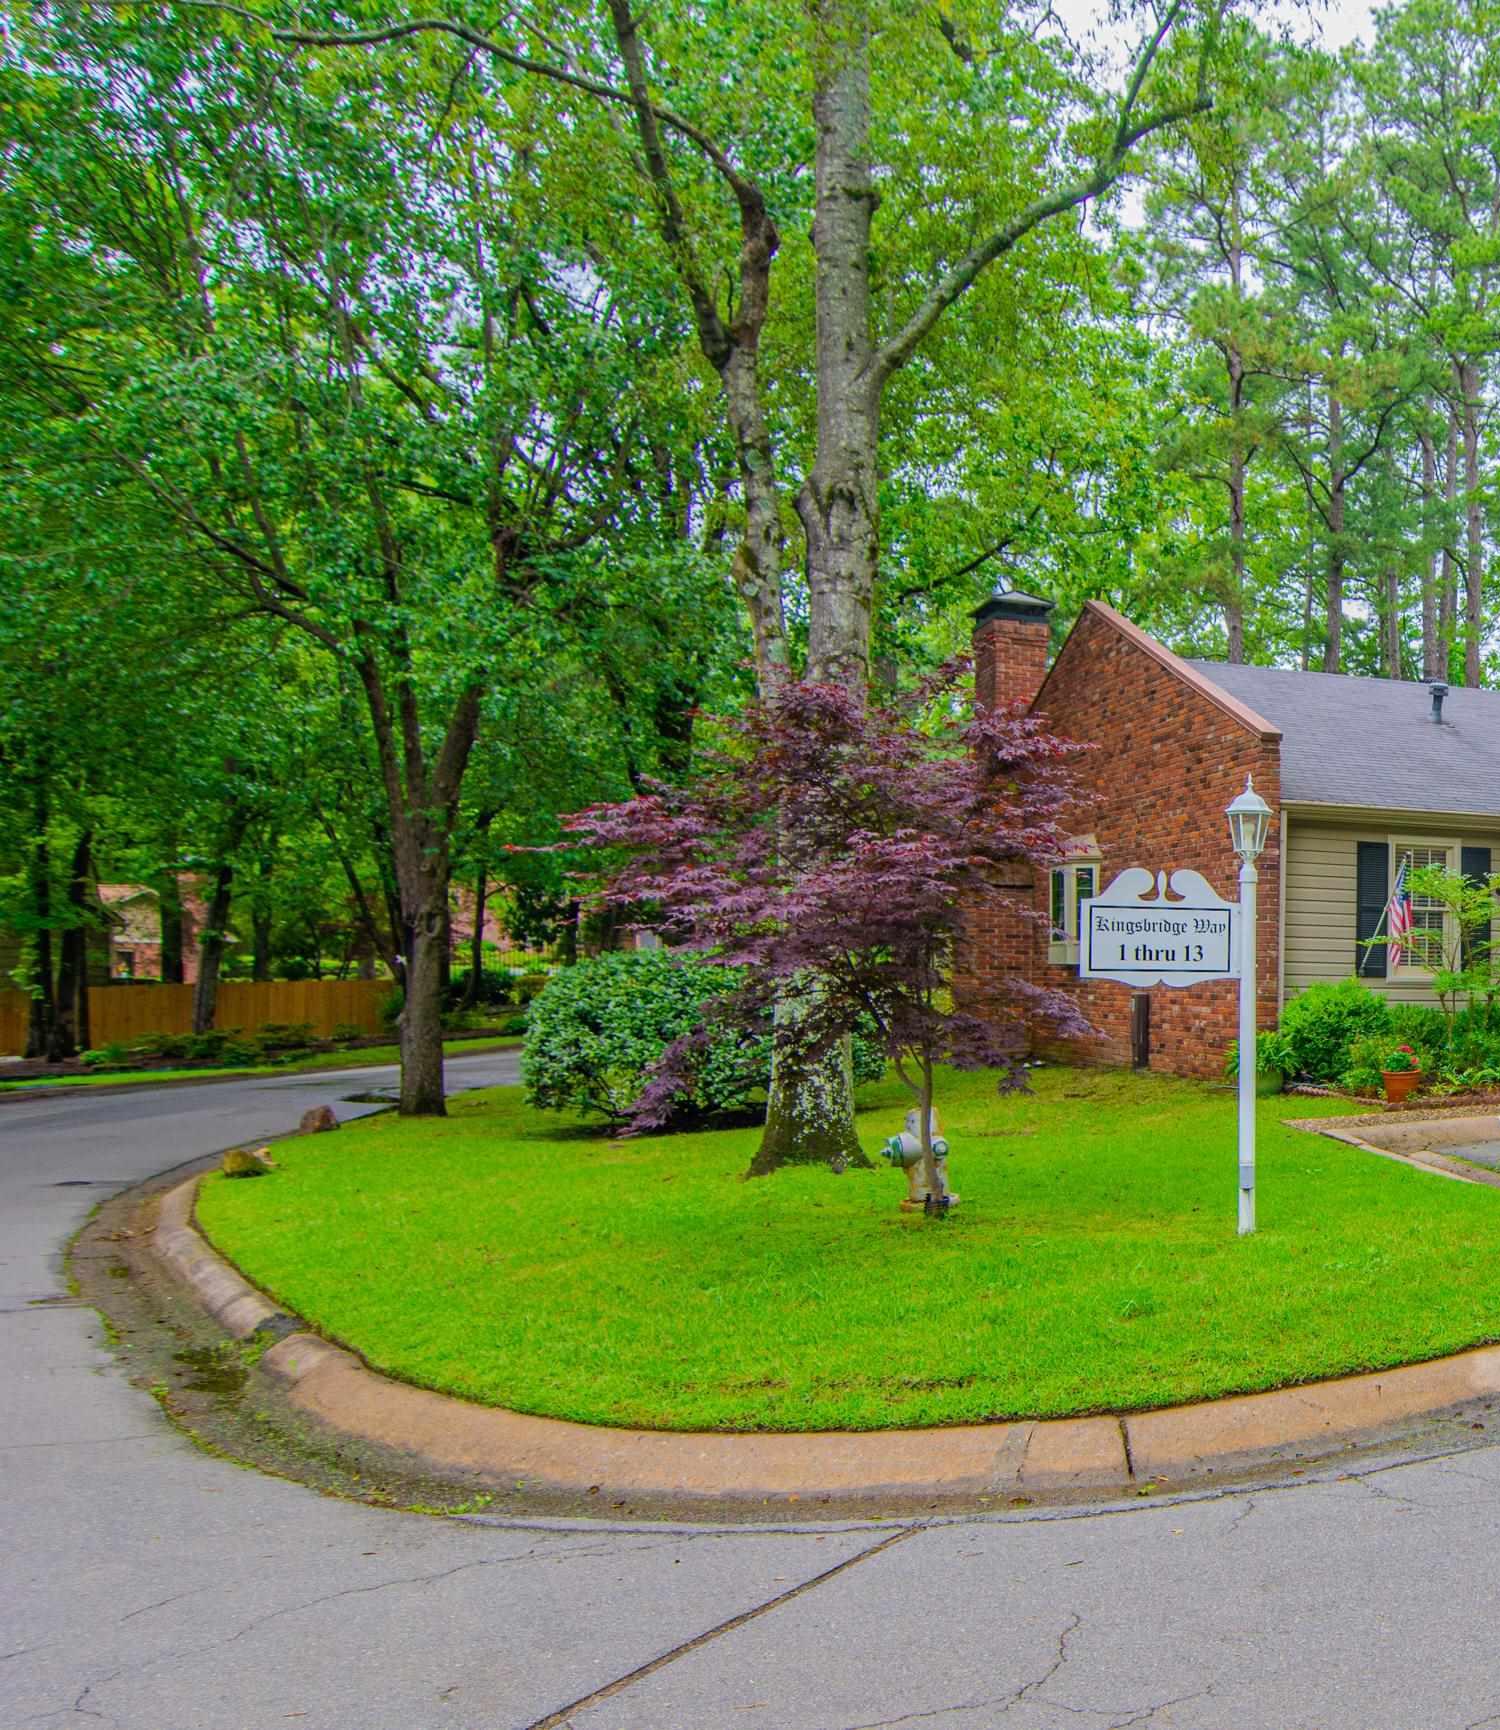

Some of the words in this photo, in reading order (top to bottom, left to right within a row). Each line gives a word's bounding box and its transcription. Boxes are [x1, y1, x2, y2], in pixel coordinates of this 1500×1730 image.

[1096, 916, 1187, 935] Kingsbridge
[1193, 918, 1226, 935] Way
[1119, 944, 1126, 961] 1
[1134, 944, 1176, 962] thru
[1184, 944, 1204, 962] 13
